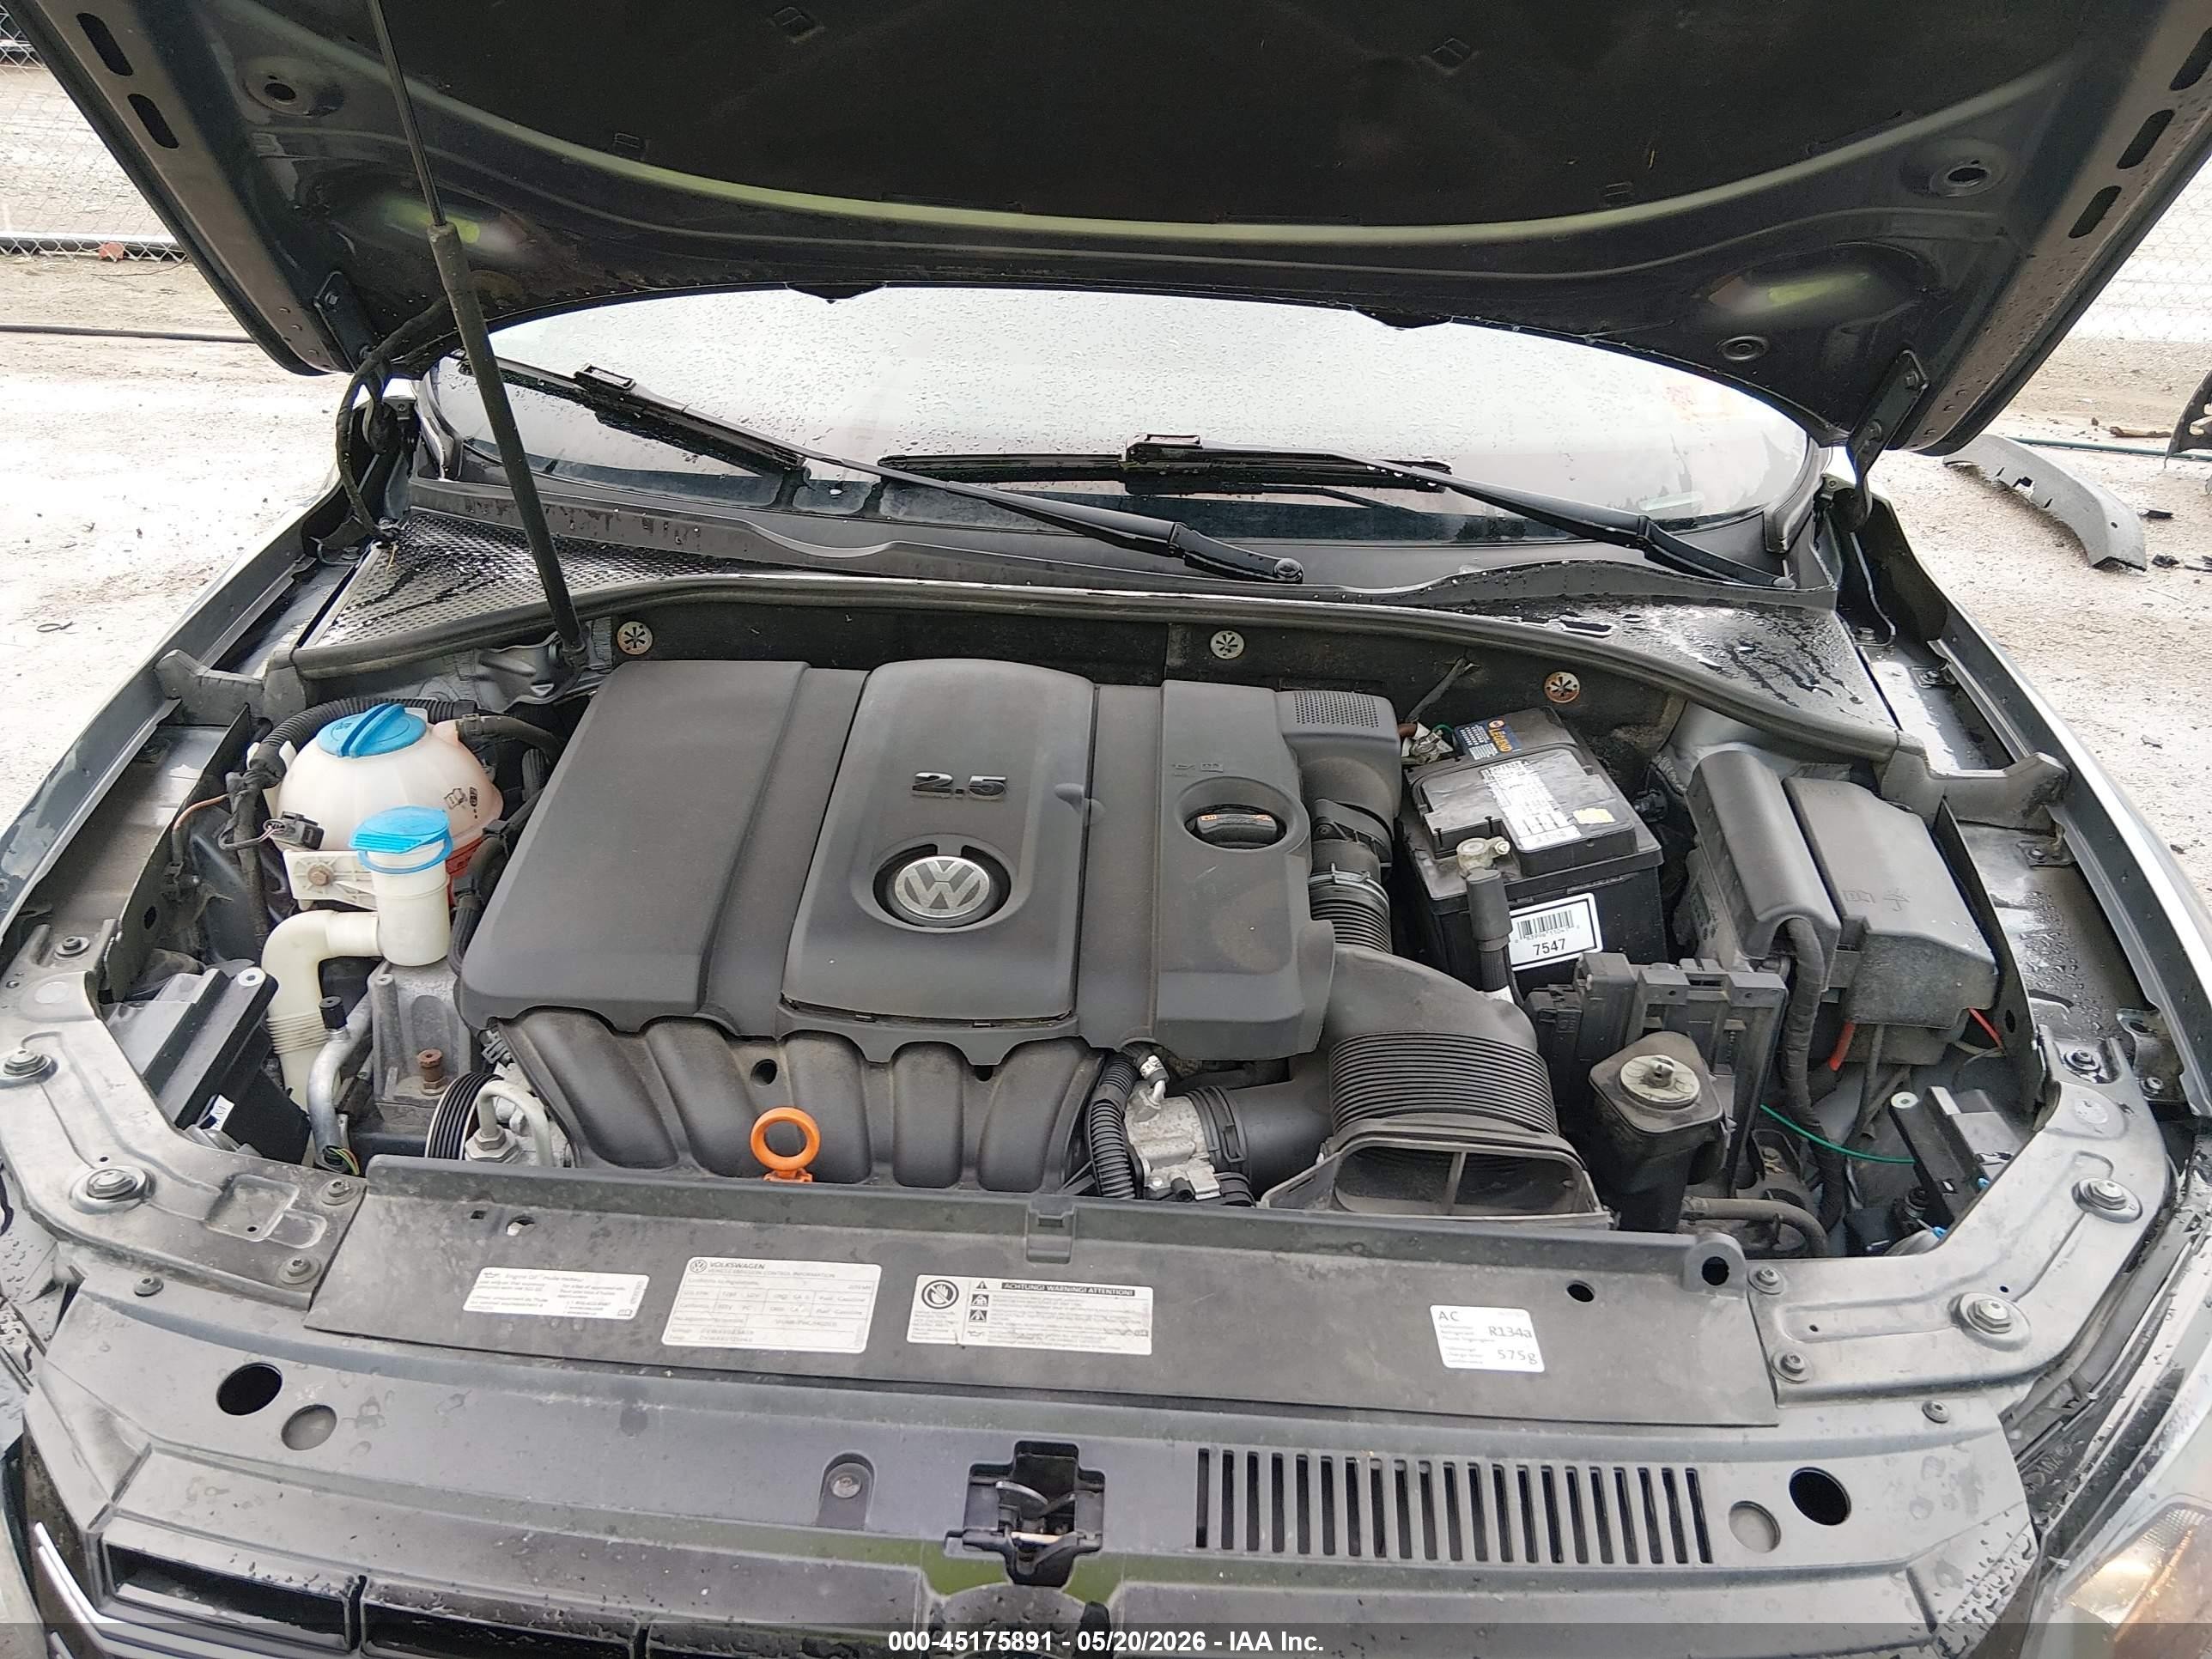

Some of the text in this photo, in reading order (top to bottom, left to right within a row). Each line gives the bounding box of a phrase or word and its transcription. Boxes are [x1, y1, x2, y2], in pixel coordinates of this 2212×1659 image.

[912, 771, 1007, 798] 2.5
[1533, 939, 1566, 956] 7547
[709, 1261, 765, 1270] VOLKSWAGEN
[1046, 1285, 1087, 1293] WARNING!
[1488, 1325, 1533, 1339] R134a
[1497, 1348, 1538, 1365] 575g
